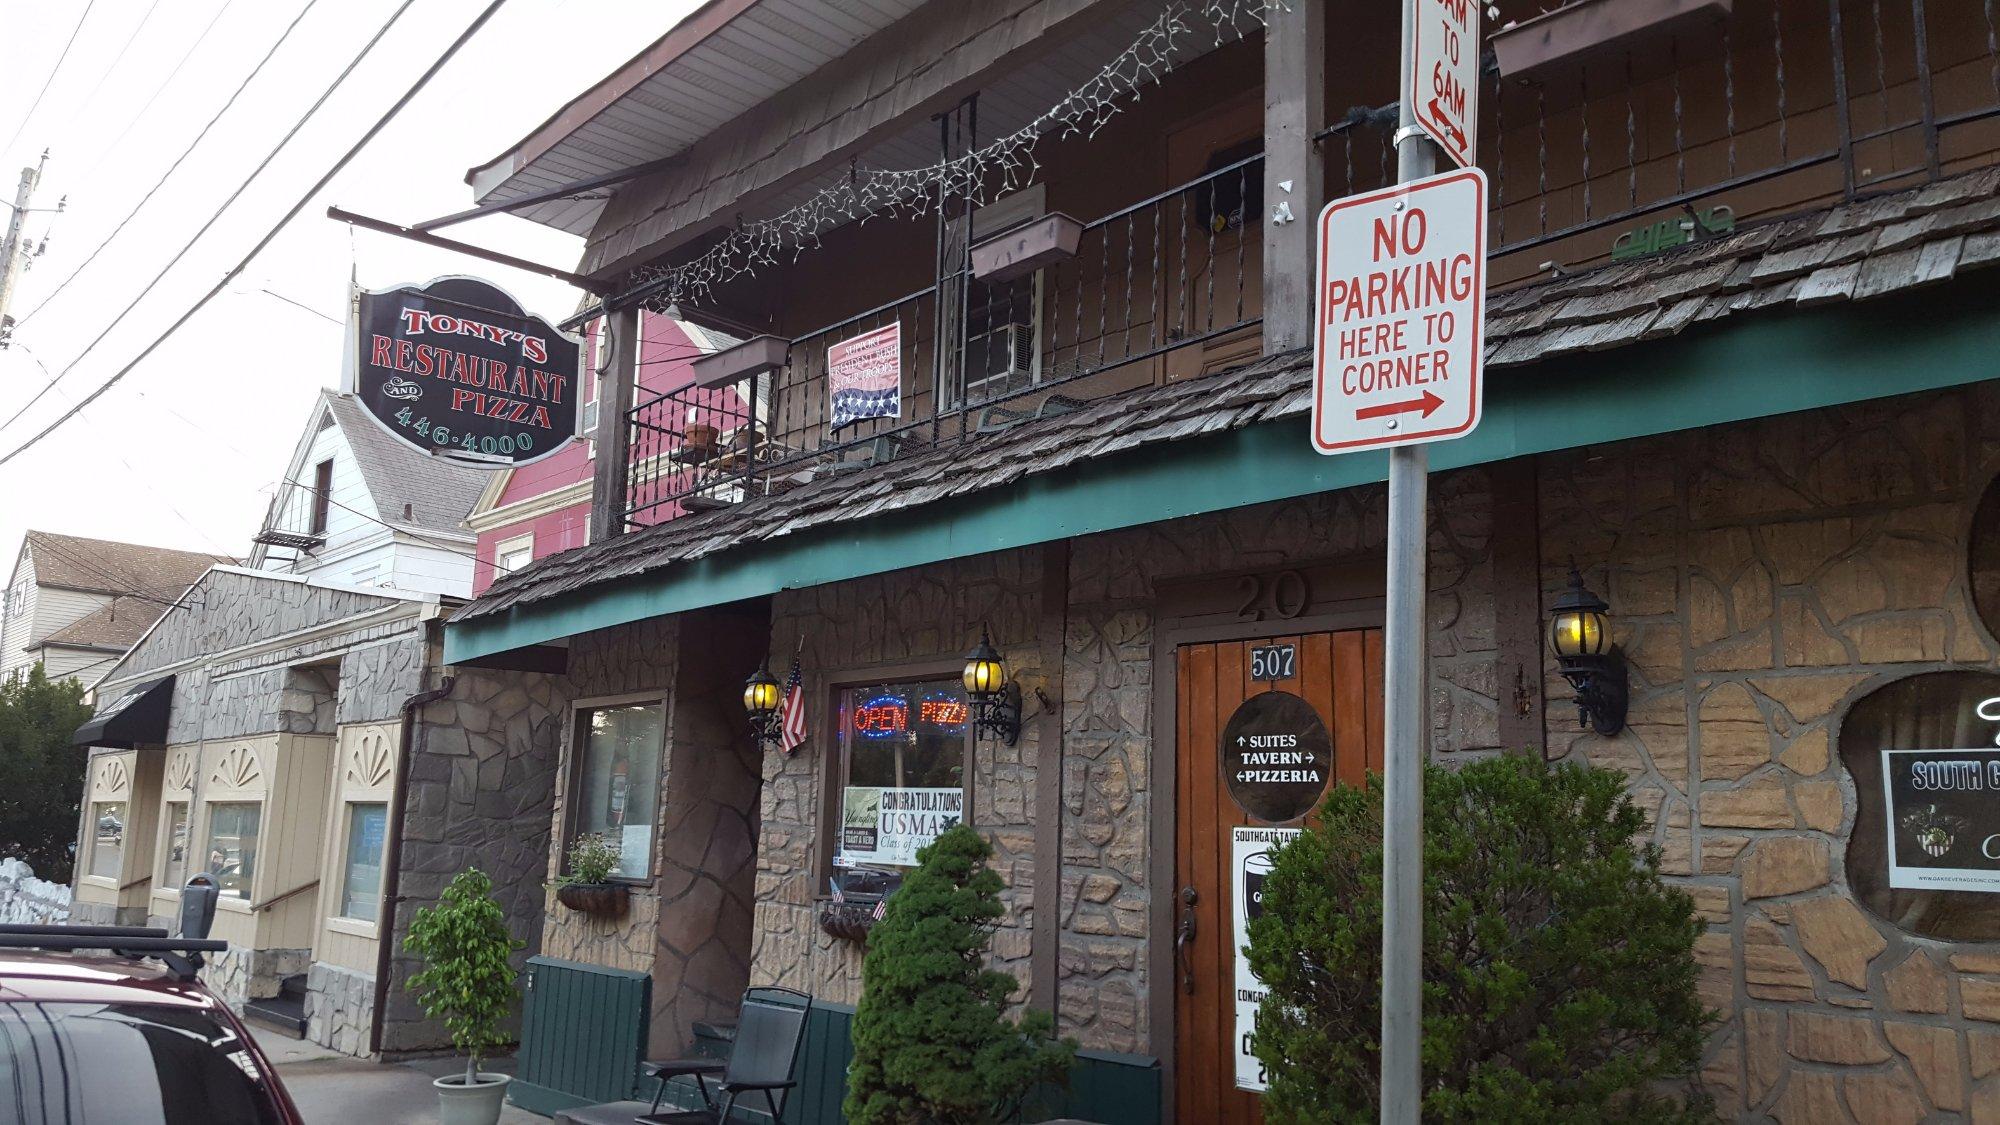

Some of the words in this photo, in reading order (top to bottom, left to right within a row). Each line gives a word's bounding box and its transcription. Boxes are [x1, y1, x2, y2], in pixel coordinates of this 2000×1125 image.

[1437, 0, 1466, 34] AM
[1442, 19, 1459, 66] TO
[1433, 60, 1466, 124] 6AM
[1373, 207, 1427, 263] NO
[1327, 253, 1472, 325] PARKING
[401, 306, 548, 364] TONY'S
[845, 336, 880, 356] SUPPORT
[1339, 319, 1408, 360] HERE
[1423, 311, 1455, 345] TO
[880, 344, 897, 359] BUSH
[370, 334, 567, 404] RESTAURANT
[860, 362, 893, 379] TROOPS
[1342, 349, 1450, 396] CORNER
[389, 386, 418, 395] AND
[451, 388, 553, 430] PIZZA
[1252, 647, 1294, 677] 507
[855, 705, 908, 732] OPEN
[1249, 734, 1297, 748] SUITES
[1240, 752, 1302, 766] TAVERN
[1245, 770, 1320, 783] PIZZERIA
[1911, 760, 1983, 791] SOUTH
[882, 791, 962, 812] CONGRATULATIONS
[881, 812, 940, 836] USMA
[1235, 830, 1279, 843] SOUTHGATE
[880, 835, 900, 848] Class
[903, 836, 914, 853] of
